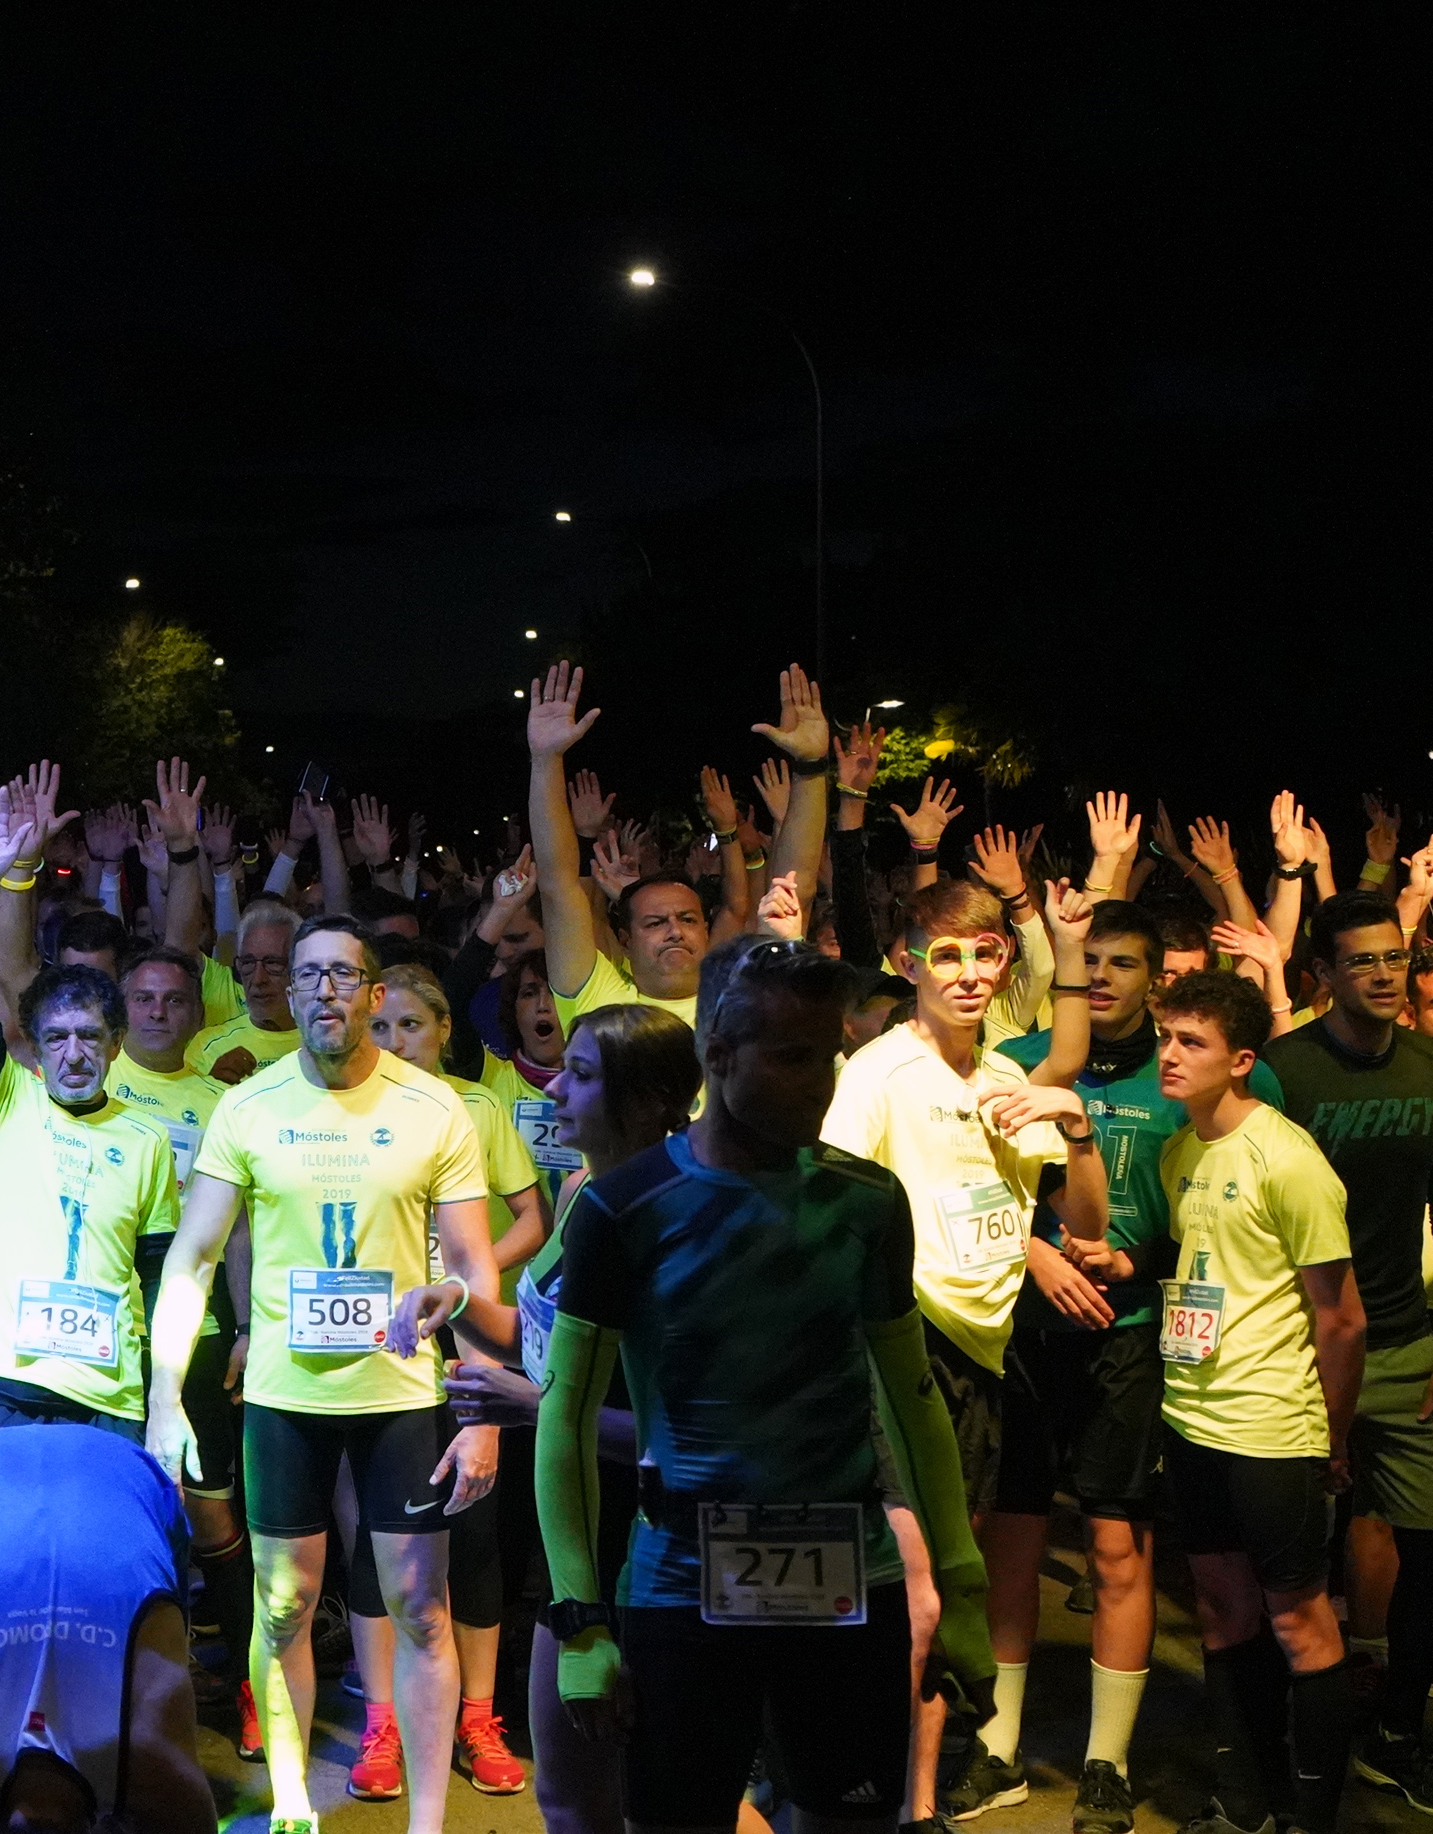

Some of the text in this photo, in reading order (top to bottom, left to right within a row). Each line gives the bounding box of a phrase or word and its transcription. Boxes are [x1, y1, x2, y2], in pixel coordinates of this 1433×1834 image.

[295, 1131, 348, 1142] Móstoles
[302, 1154, 371, 1167] ILUMINA
[311, 1172, 362, 1183] MÓSTOLES
[322, 1189, 352, 1199] 2019
[968, 1209, 1015, 1245] 760
[40, 1307, 98, 1337] 184
[308, 1298, 372, 1326] 508
[1168, 1309, 1214, 1340] 1812
[734, 1547, 824, 1587] 271
